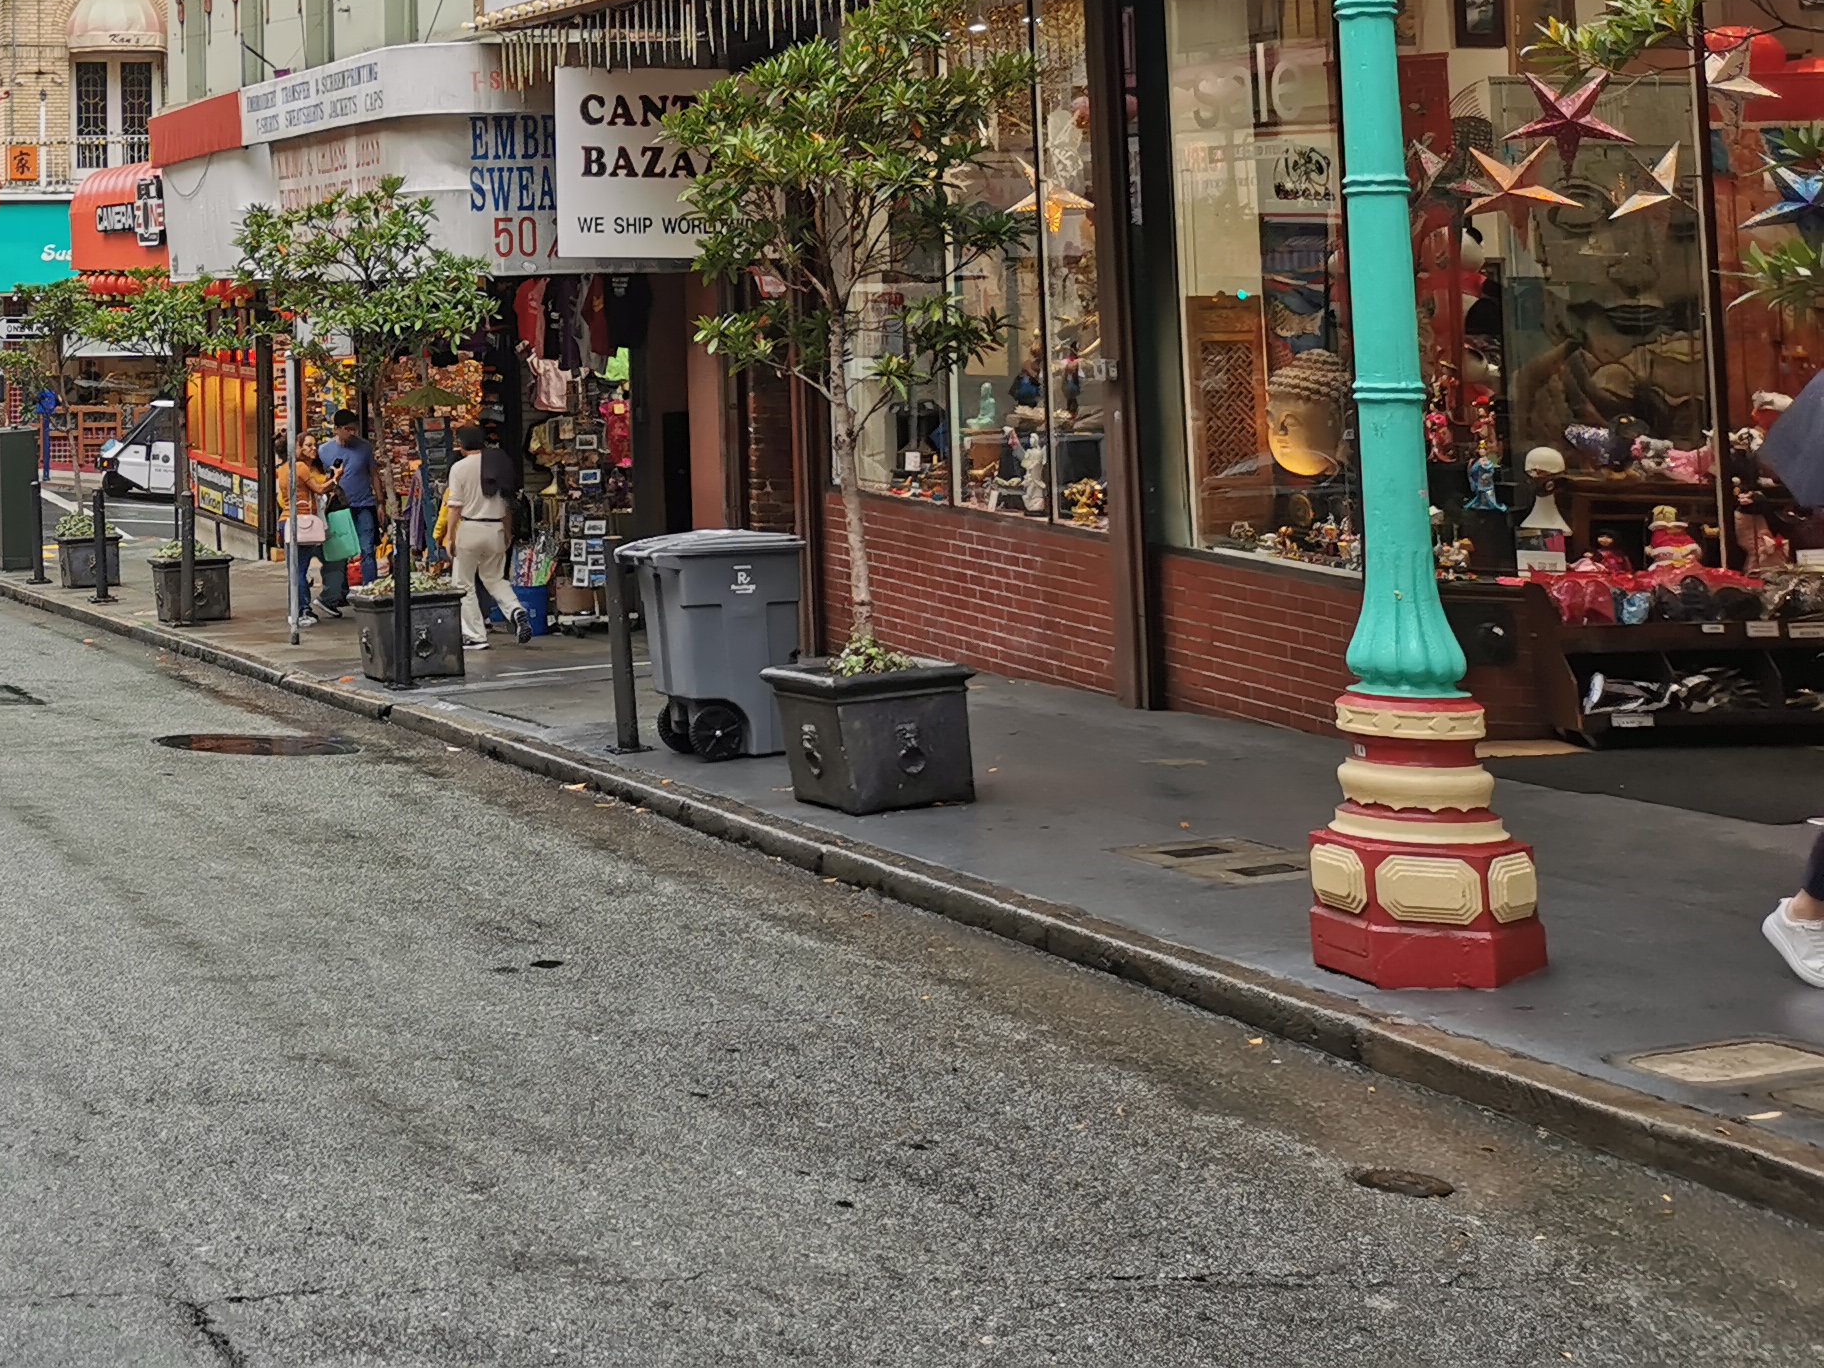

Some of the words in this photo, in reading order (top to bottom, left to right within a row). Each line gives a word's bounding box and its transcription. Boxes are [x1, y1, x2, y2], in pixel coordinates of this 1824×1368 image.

[364, 90, 384, 112] CAPS
[579, 93, 699, 128] CANT
[580, 145, 716, 179] BAZA
[96, 203, 134, 232] CAMERA
[578, 216, 605, 235] WE
[613, 216, 653, 235] SHIP
